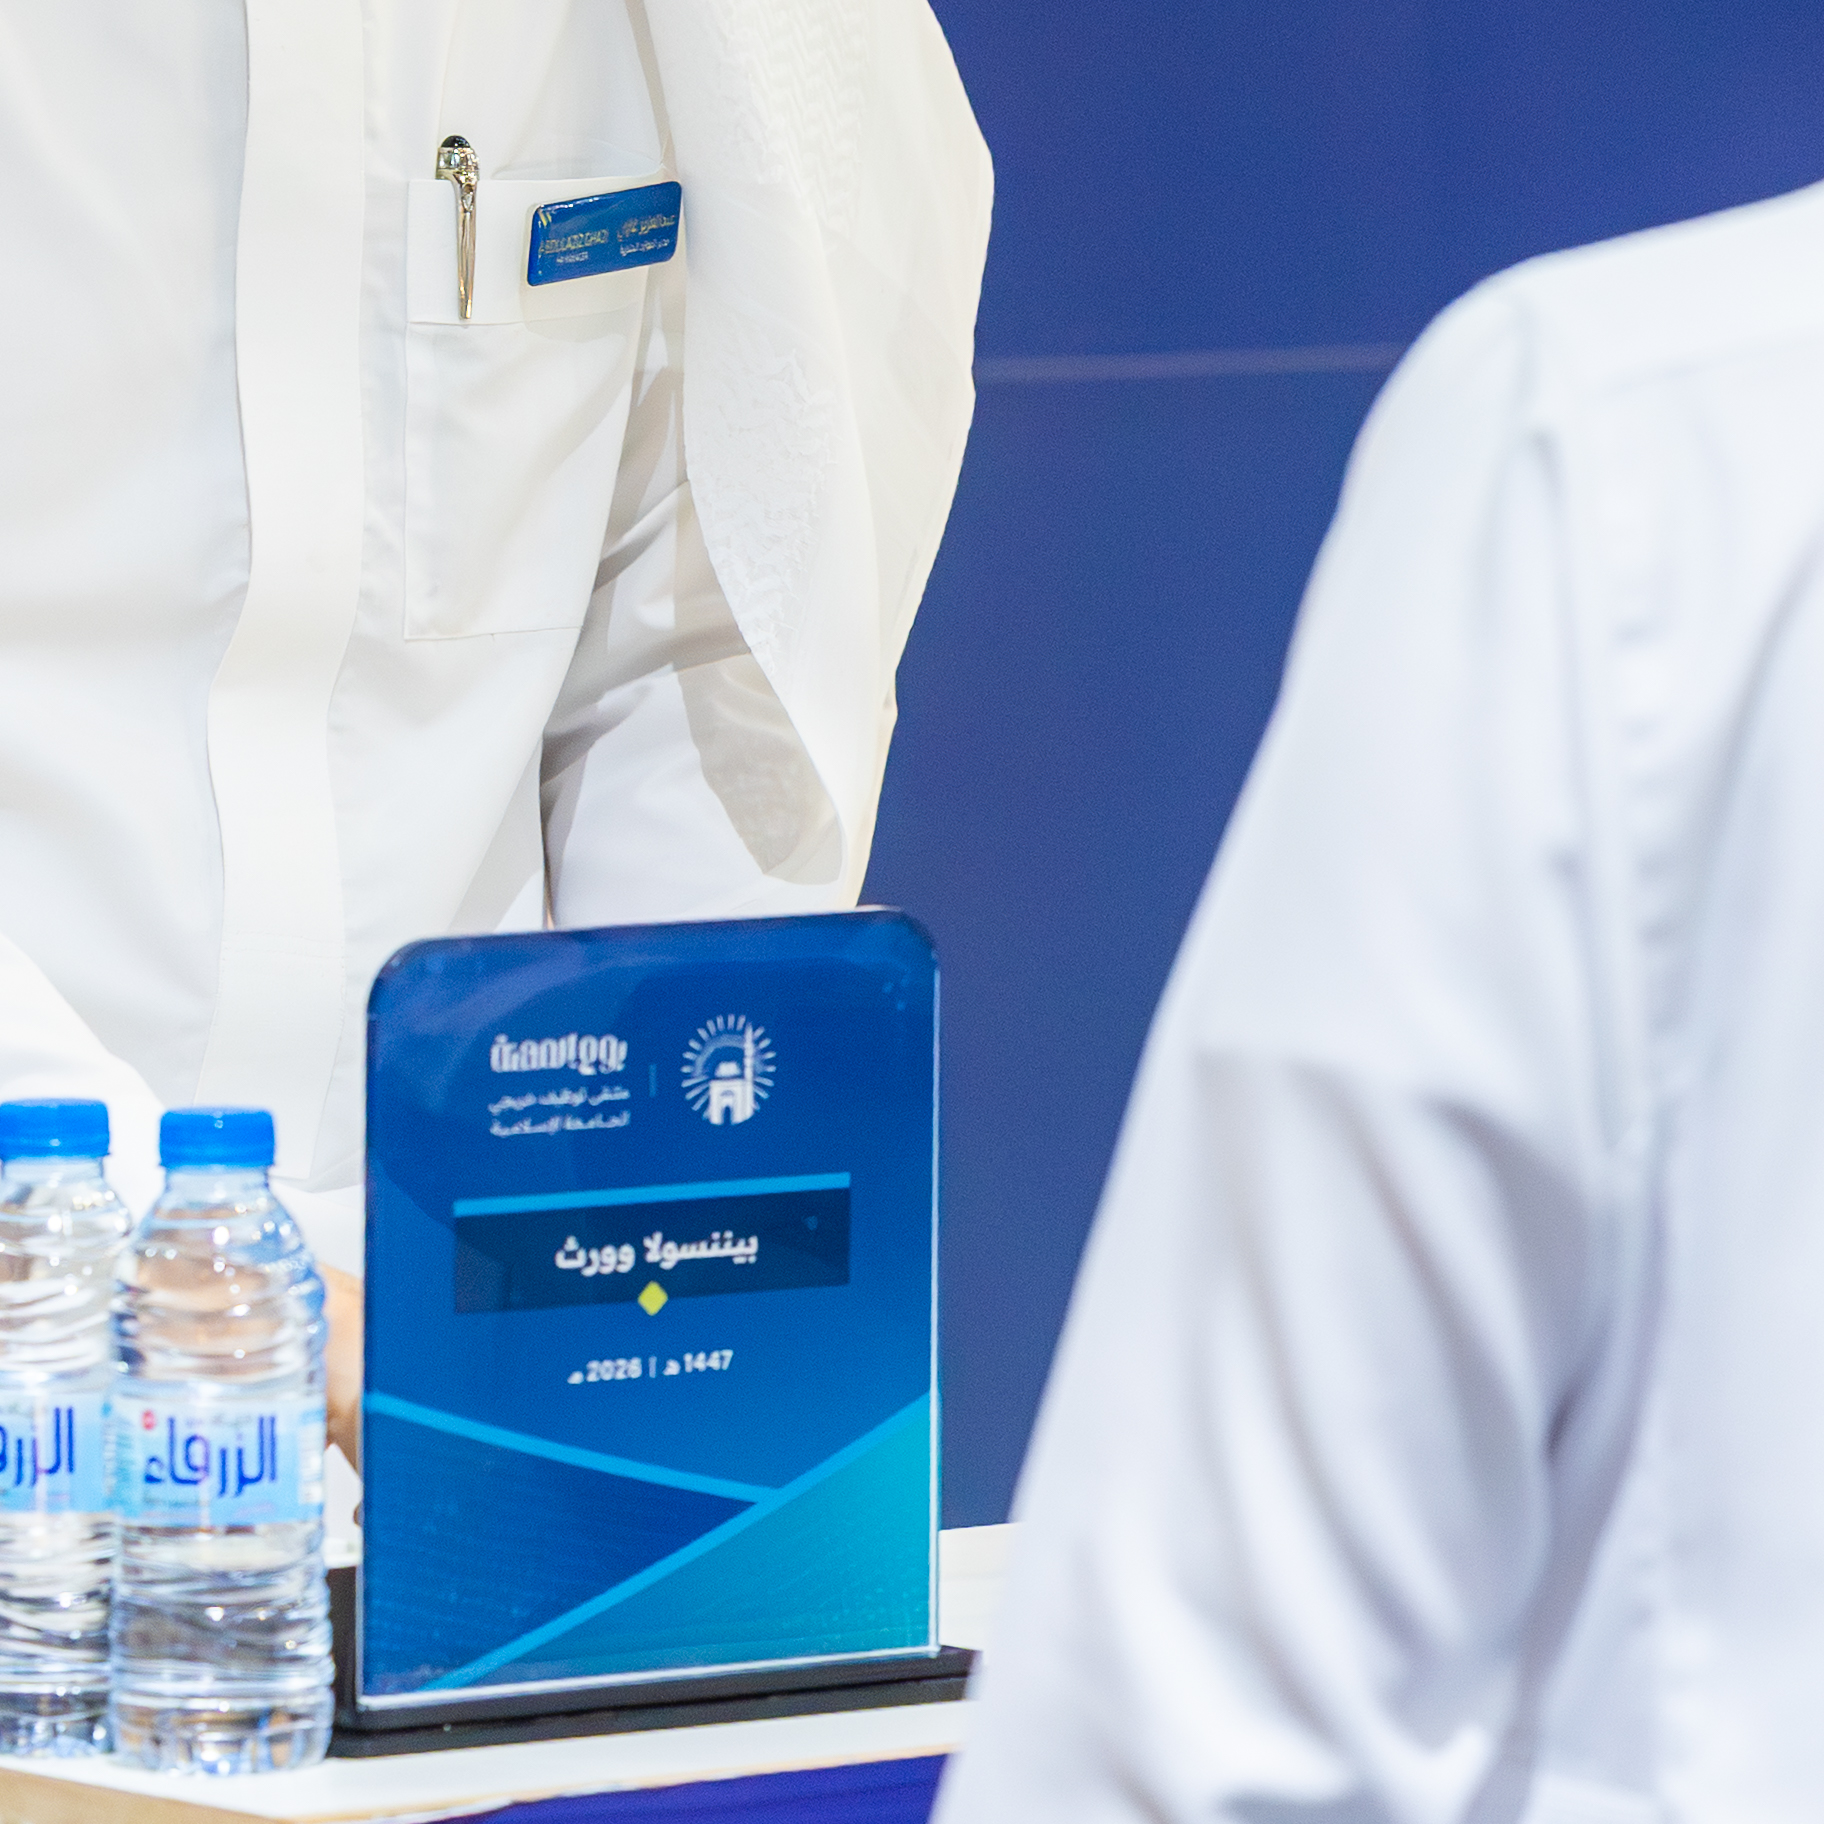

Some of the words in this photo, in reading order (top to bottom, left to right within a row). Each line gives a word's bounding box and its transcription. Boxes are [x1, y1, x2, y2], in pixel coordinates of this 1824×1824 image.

[554, 1235, 636, 1277] وورث
[642, 1230, 759, 1271] بيننسولا
[143, 1414, 278, 1499] الزرقاء
